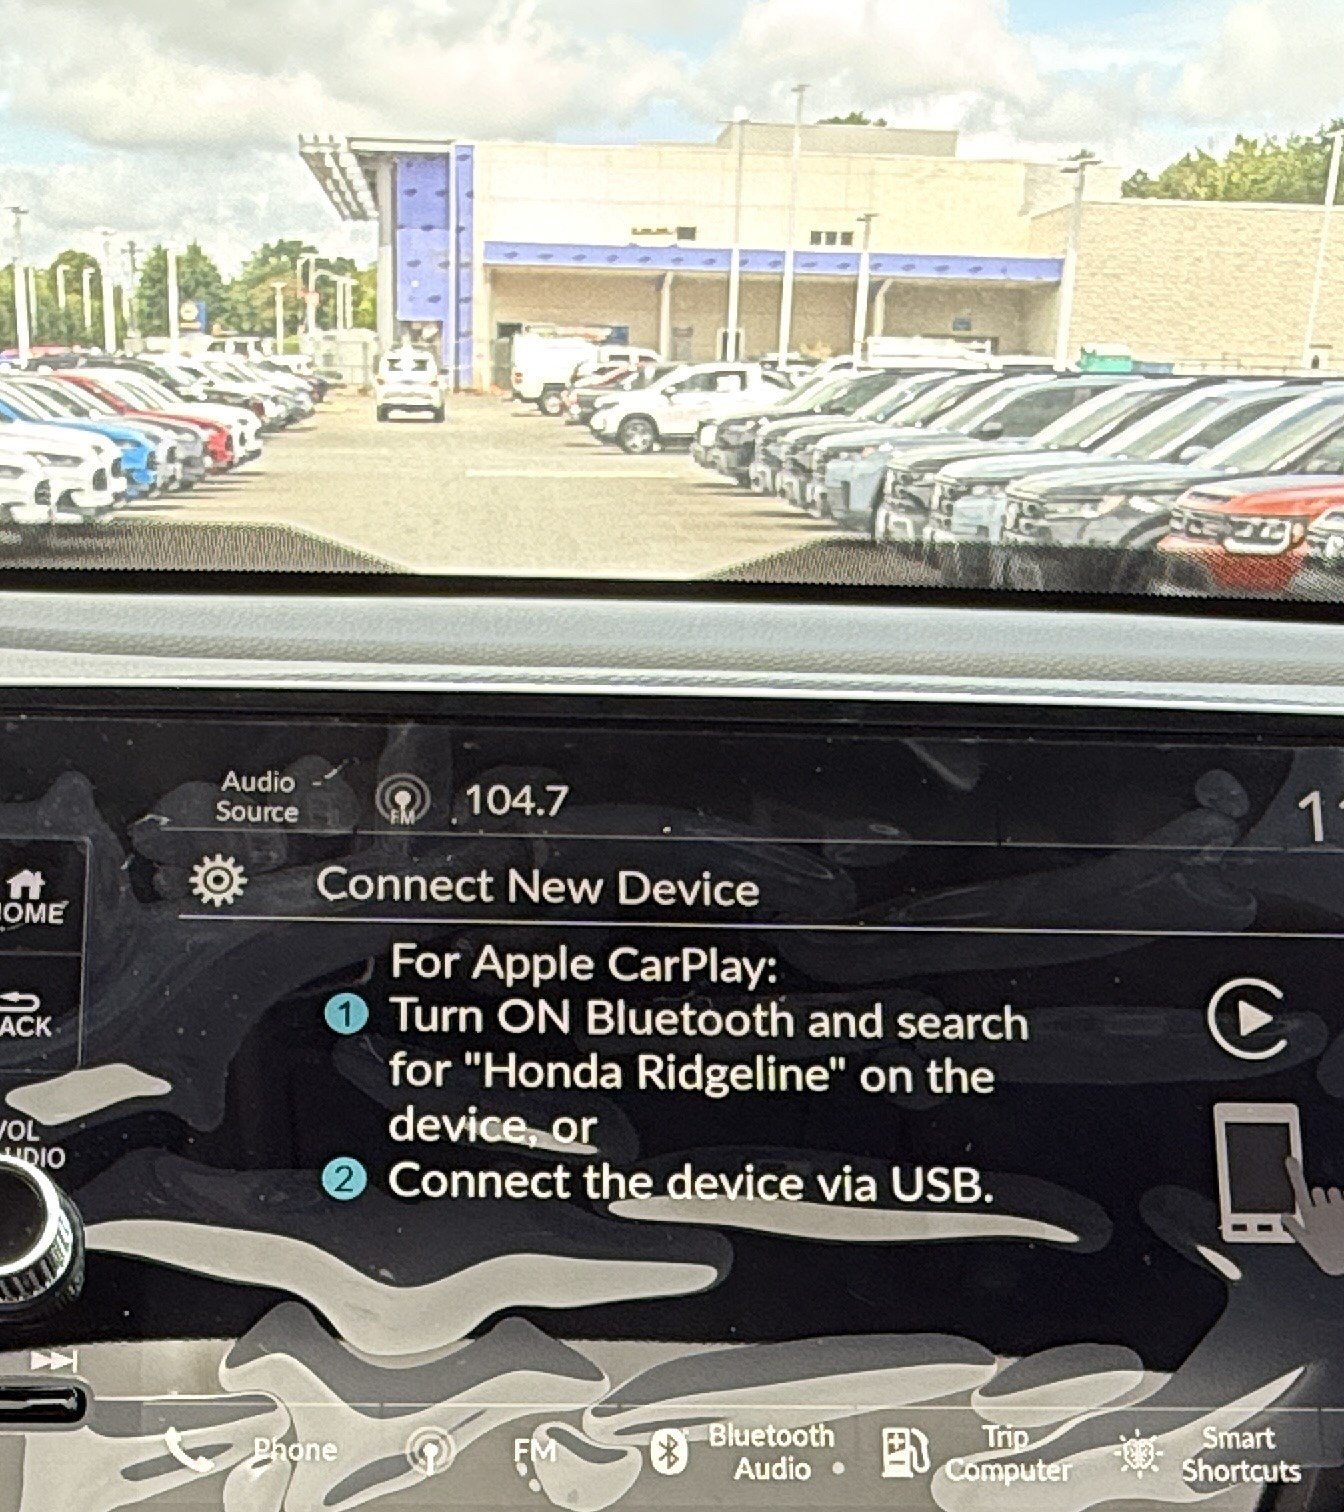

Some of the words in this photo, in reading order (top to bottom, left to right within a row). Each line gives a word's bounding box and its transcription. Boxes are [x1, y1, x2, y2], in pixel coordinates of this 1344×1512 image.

[222, 769, 296, 794] Audio
[215, 800, 299, 824] Source
[466, 783, 570, 817] 104.7
[389, 810, 416, 826] FM
[317, 866, 494, 903] Connect
[508, 868, 604, 905] New
[618, 870, 759, 907] Device
[391, 942, 459, 979] For
[471, 944, 594, 988] Apple
[608, 945, 777, 992] CarPlay:
[337, 1001, 352, 1028] 1
[388, 995, 484, 1034] Turn
[497, 998, 571, 1034] ON
[587, 998, 795, 1036] Bluetooth
[808, 1002, 883, 1039] and
[897, 1004, 1029, 1041] search
[389, 1051, 452, 1087] for
[464, 1051, 622, 1089] "Honda
[638, 1053, 846, 1098] Ridgeline"
[859, 1066, 914, 1094] on
[926, 1057, 996, 1094] the
[388, 1104, 539, 1149] device,
[552, 1116, 598, 1144] or
[334, 1165, 354, 1192] 2
[388, 1161, 571, 1197] Connect
[582, 1162, 654, 1199] the
[666, 1163, 805, 1201] device
[816, 1165, 878, 1202] via
[891, 1166, 995, 1204] USB.
[708, 1423, 835, 1448] Bluetooth
[982, 1425, 1030, 1451] Trip
[1203, 1426, 1276, 1451] Smart
[253, 1436, 339, 1464] Phone
[513, 1438, 558, 1464] FM
[734, 1456, 812, 1482] Audio
[945, 1457, 1073, 1486] Computer
[1182, 1459, 1302, 1484] Shortcuts
